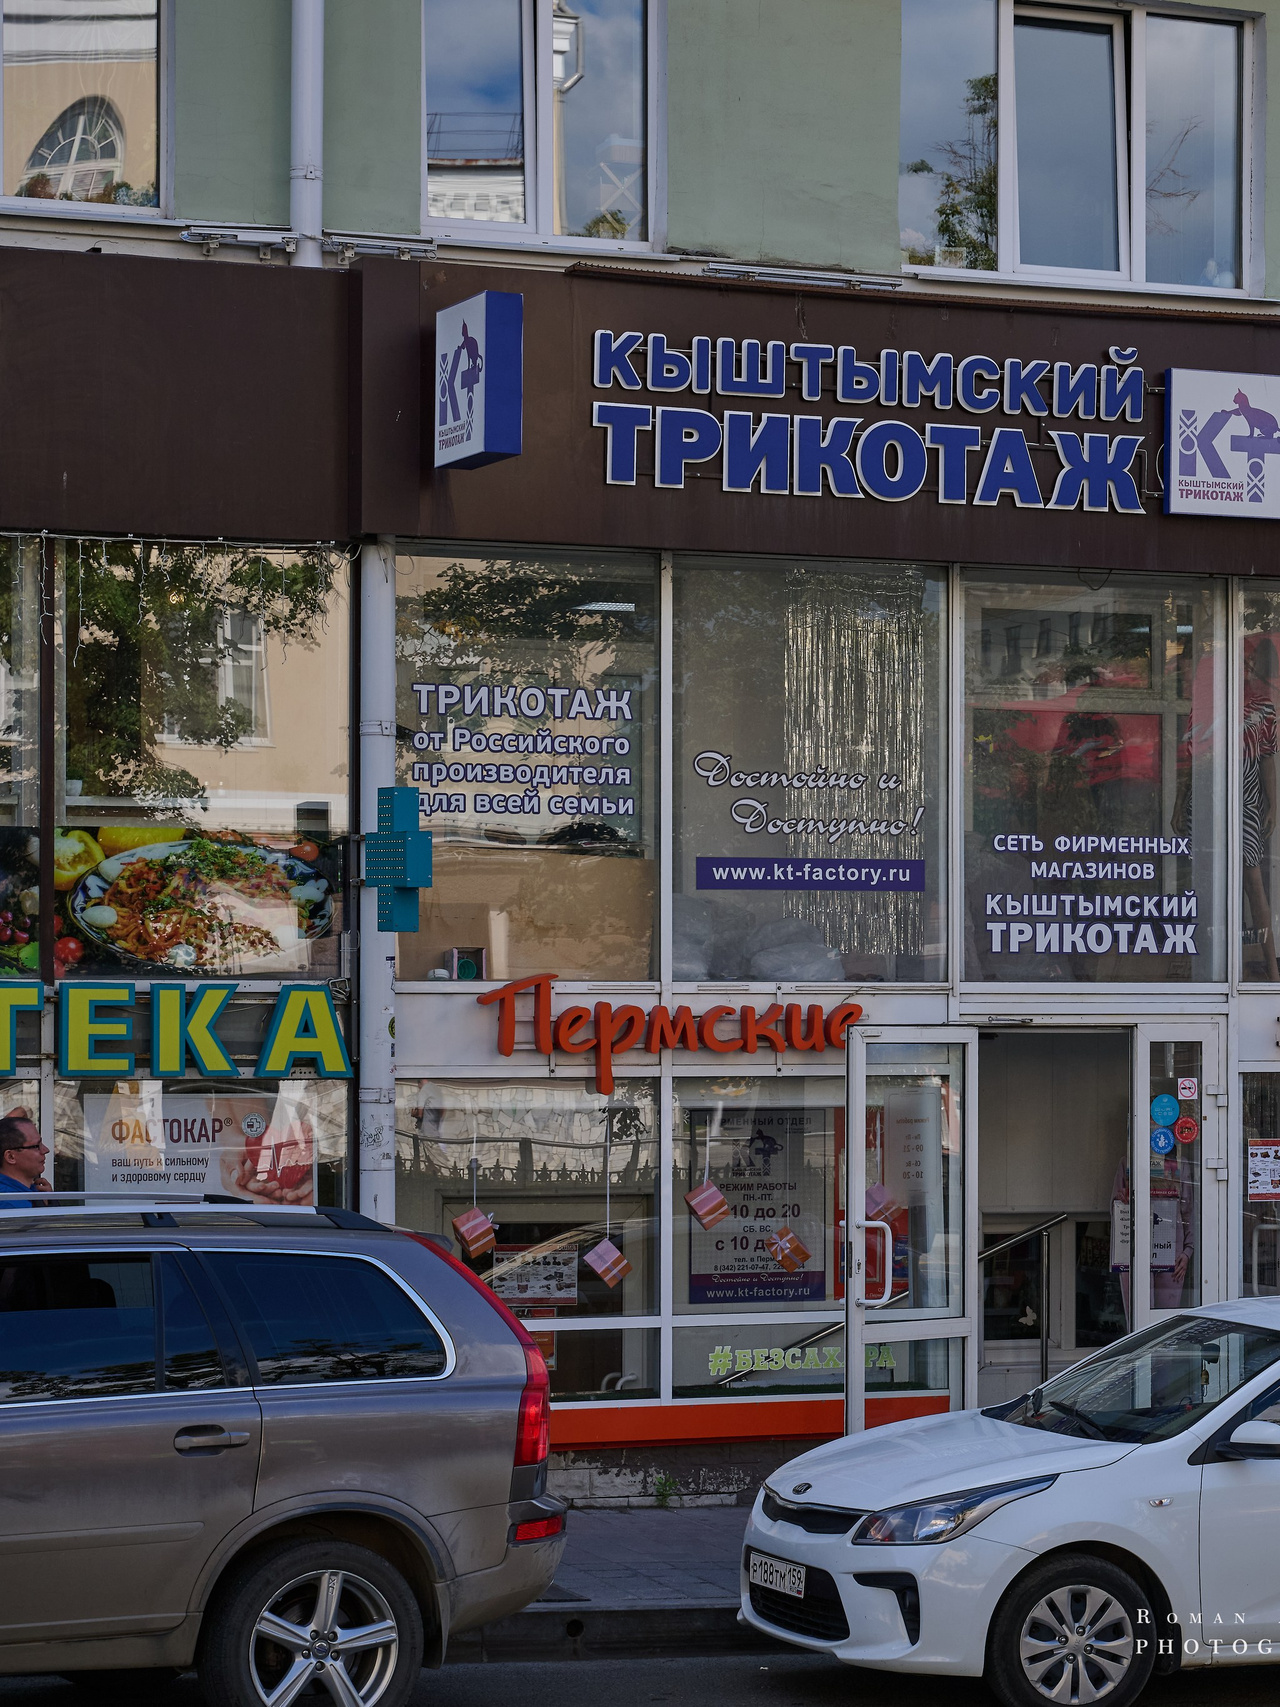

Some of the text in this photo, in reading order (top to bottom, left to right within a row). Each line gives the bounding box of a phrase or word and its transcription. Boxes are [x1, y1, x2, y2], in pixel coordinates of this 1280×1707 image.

[594, 329, 1145, 423] КЫШТЫМСКИЙ
[593, 401, 1147, 515] ТРИКОТАЖ
[1178, 479, 1244, 490] КЫШТЫМСКИЙ
[1178, 488, 1244, 502] ТРИКОТАЖ
[412, 683, 633, 720] ТРИКОТАЖ
[412, 727, 631, 755] от Российского
[412, 762, 632, 788] производителя
[693, 750, 902, 790] Достойно и
[418, 788, 635, 816] для всей семьи
[730, 797, 926, 844] Доступно!
[993, 834, 1190, 855] СЕТЬ ФИРМЕННЫХ
[712, 863, 911, 886] www.kt-factory.ru
[1031, 861, 1156, 880] МАГАЗИНОВ
[985, 890, 1198, 918] КЫШТЫМСКИЙ
[985, 921, 1199, 955] ТРИКОТАЖ
[0, 981, 354, 1078] ТЕКА
[476, 973, 863, 1096] Пермские
[705, 1117, 777, 1126] РМЕННЫЙ
[111, 1157, 210, 1169] ваш путь к сильному
[111, 1171, 206, 1184] и здоровому сердцу
[719, 1182, 797, 1192] РЕЖИМ РАБОТЫ
[731, 1203, 801, 1220] 10 до 20
[715, 1240, 725, 1251] с
[730, 1236, 749, 1251] 10
[706, 1286, 810, 1298] www.kt-factory.ru
[709, 1345, 896, 1376] #БЕЗСАХРА
